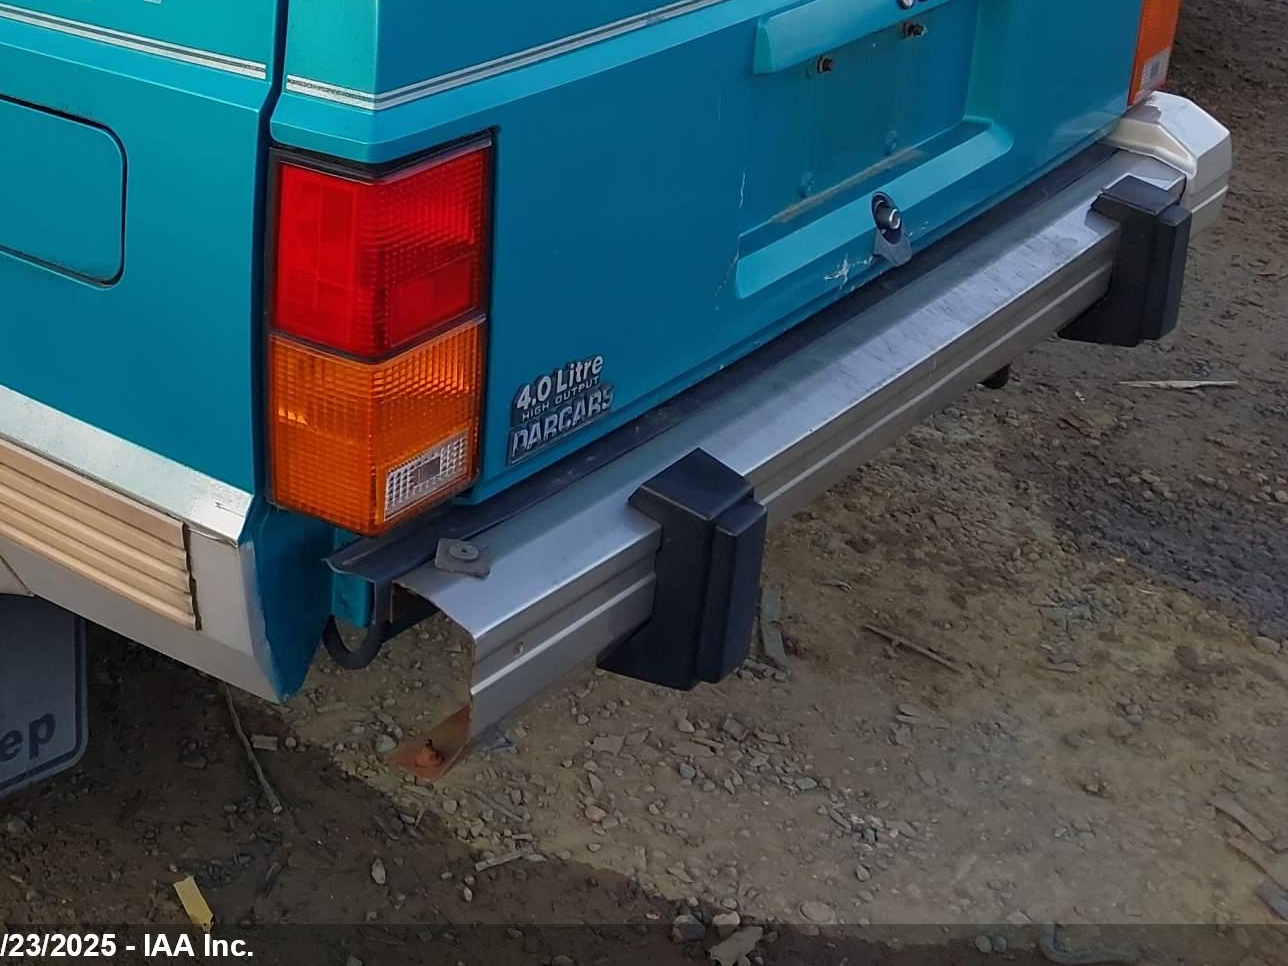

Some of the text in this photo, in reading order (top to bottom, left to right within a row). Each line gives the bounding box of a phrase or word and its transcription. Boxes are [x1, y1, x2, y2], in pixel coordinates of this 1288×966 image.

[516, 355, 604, 411] 4.0 Litre
[522, 375, 599, 422] HIGH OUTPUT
